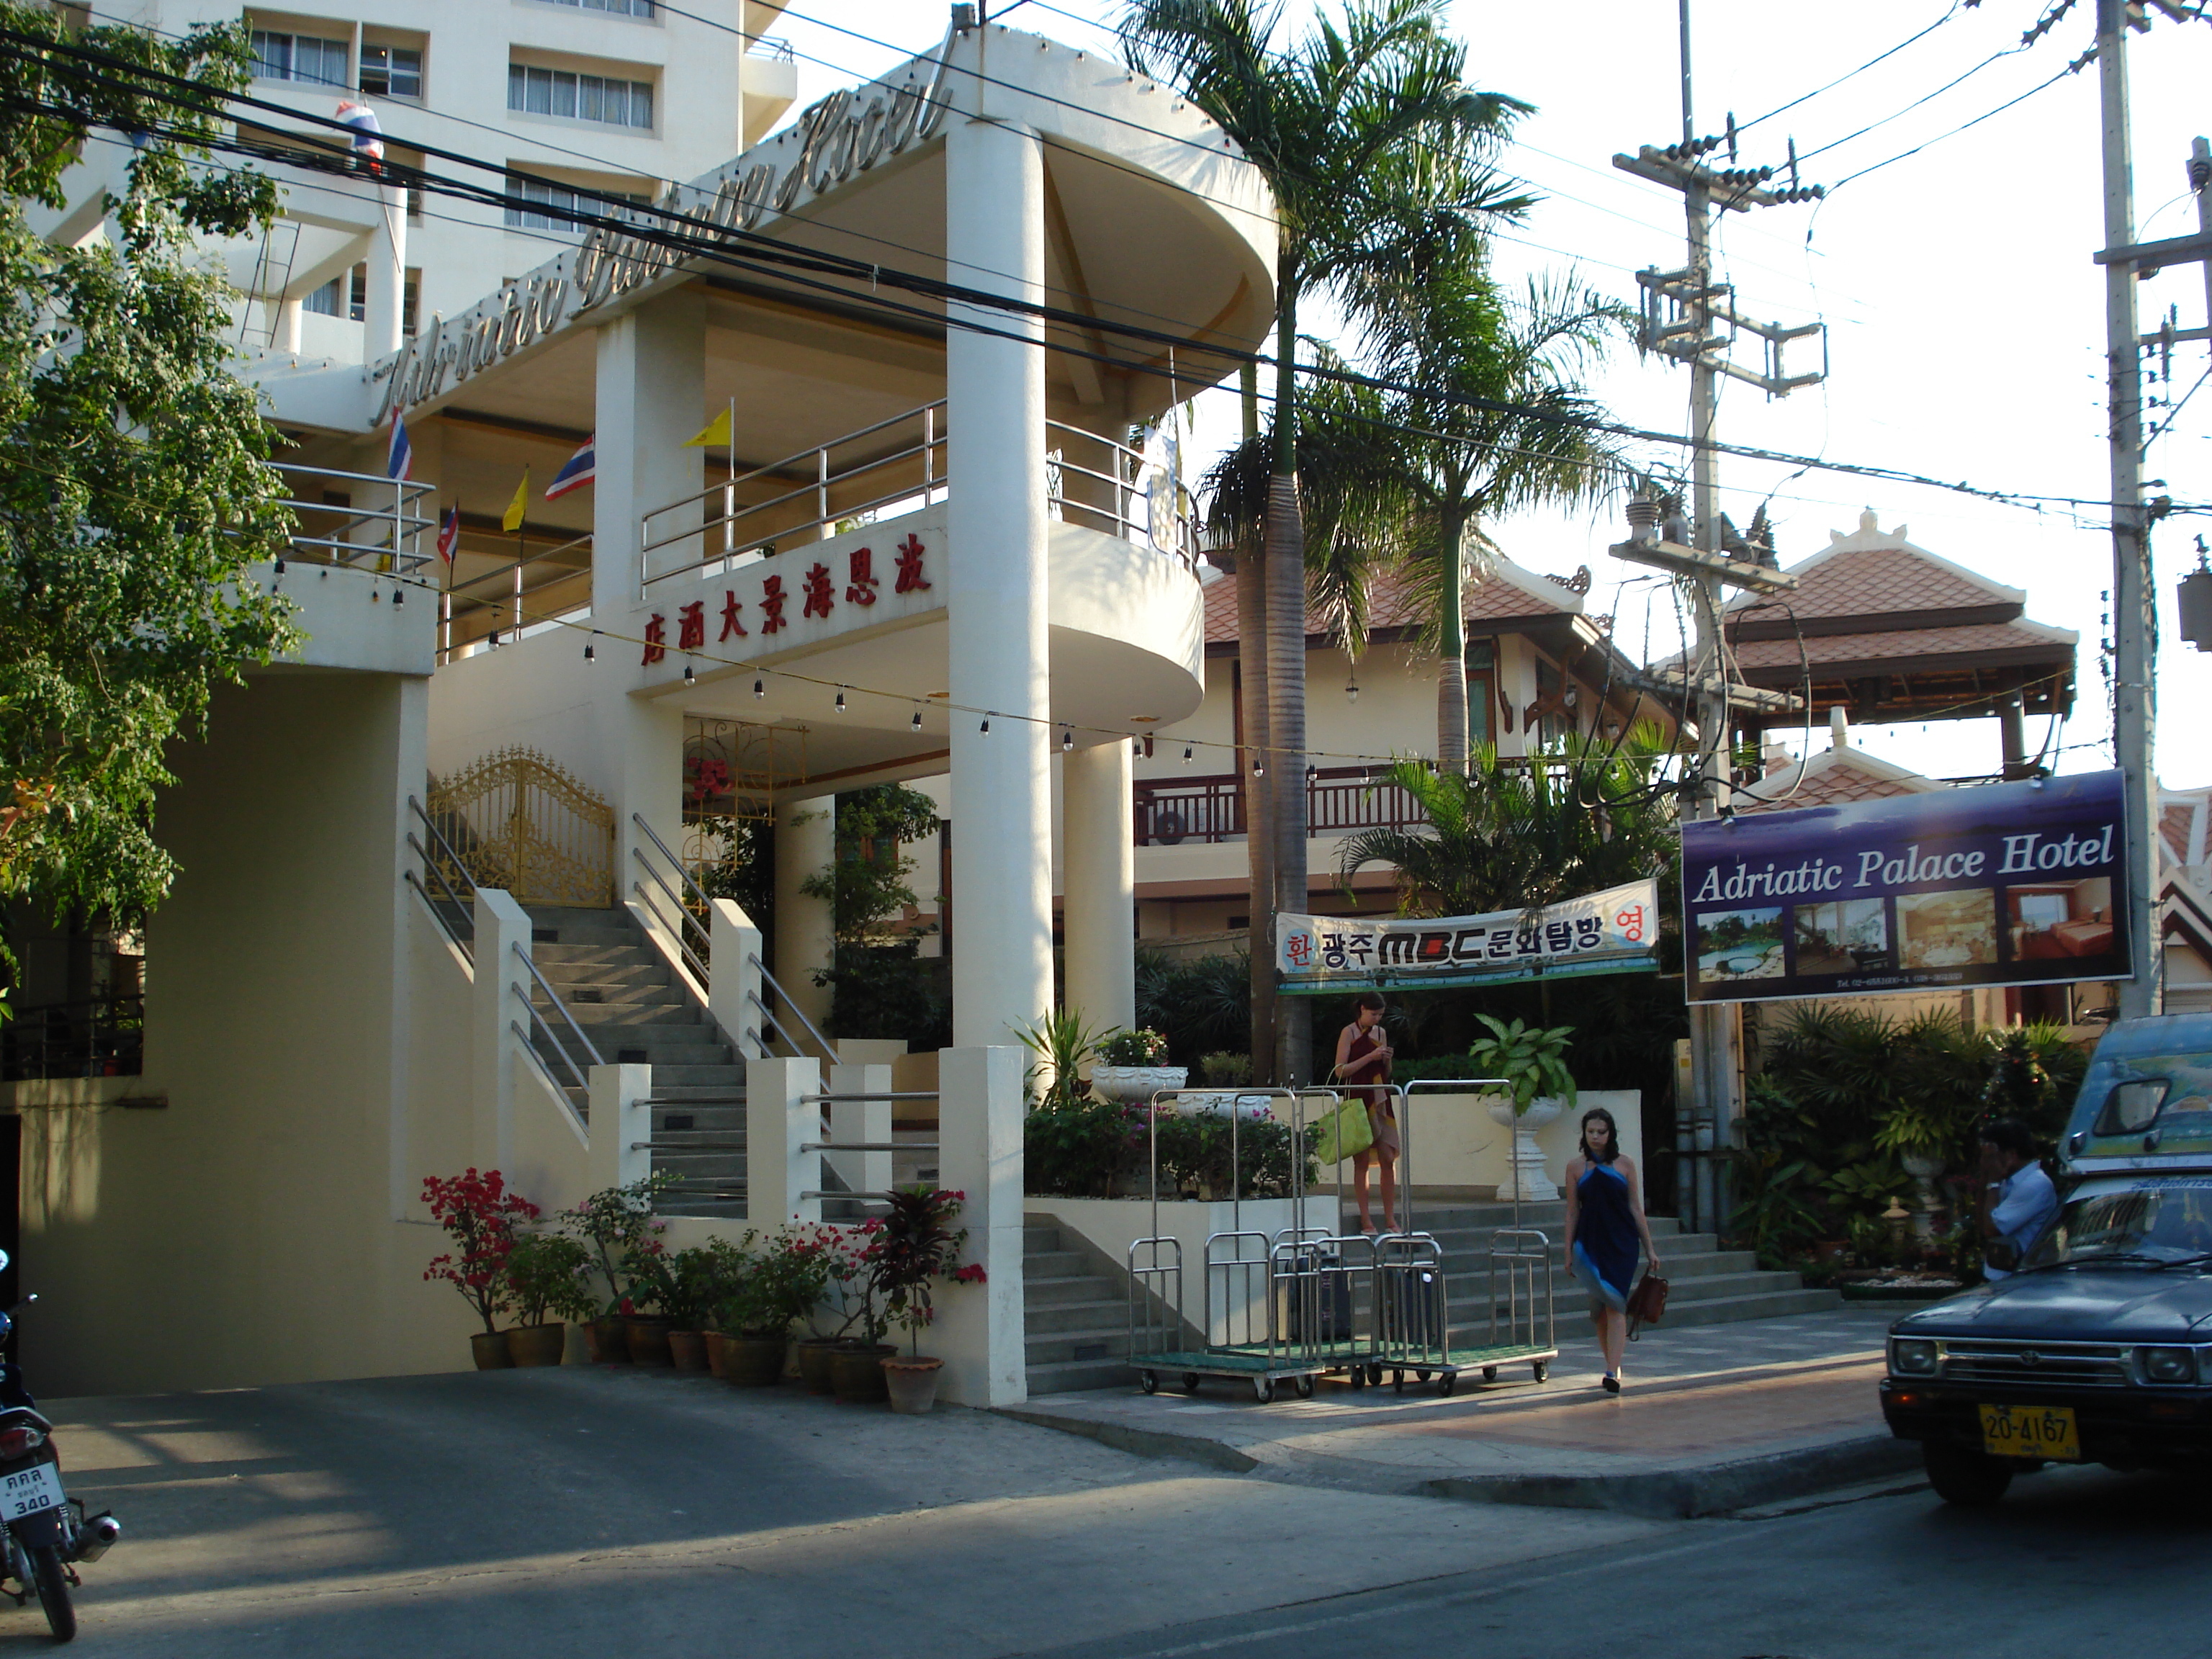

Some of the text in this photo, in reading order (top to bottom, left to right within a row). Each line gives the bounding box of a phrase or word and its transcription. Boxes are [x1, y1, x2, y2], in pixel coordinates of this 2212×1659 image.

[773, 19, 957, 212] Hotel
[1691, 824, 2115, 903] Adriatic Palace Hotel
[1286, 934, 1312, 966] 환
[1616, 905, 1644, 942] 영
[1987, 1415, 2067, 1442] 20-4167
[15, 1495, 50, 1514] 340
